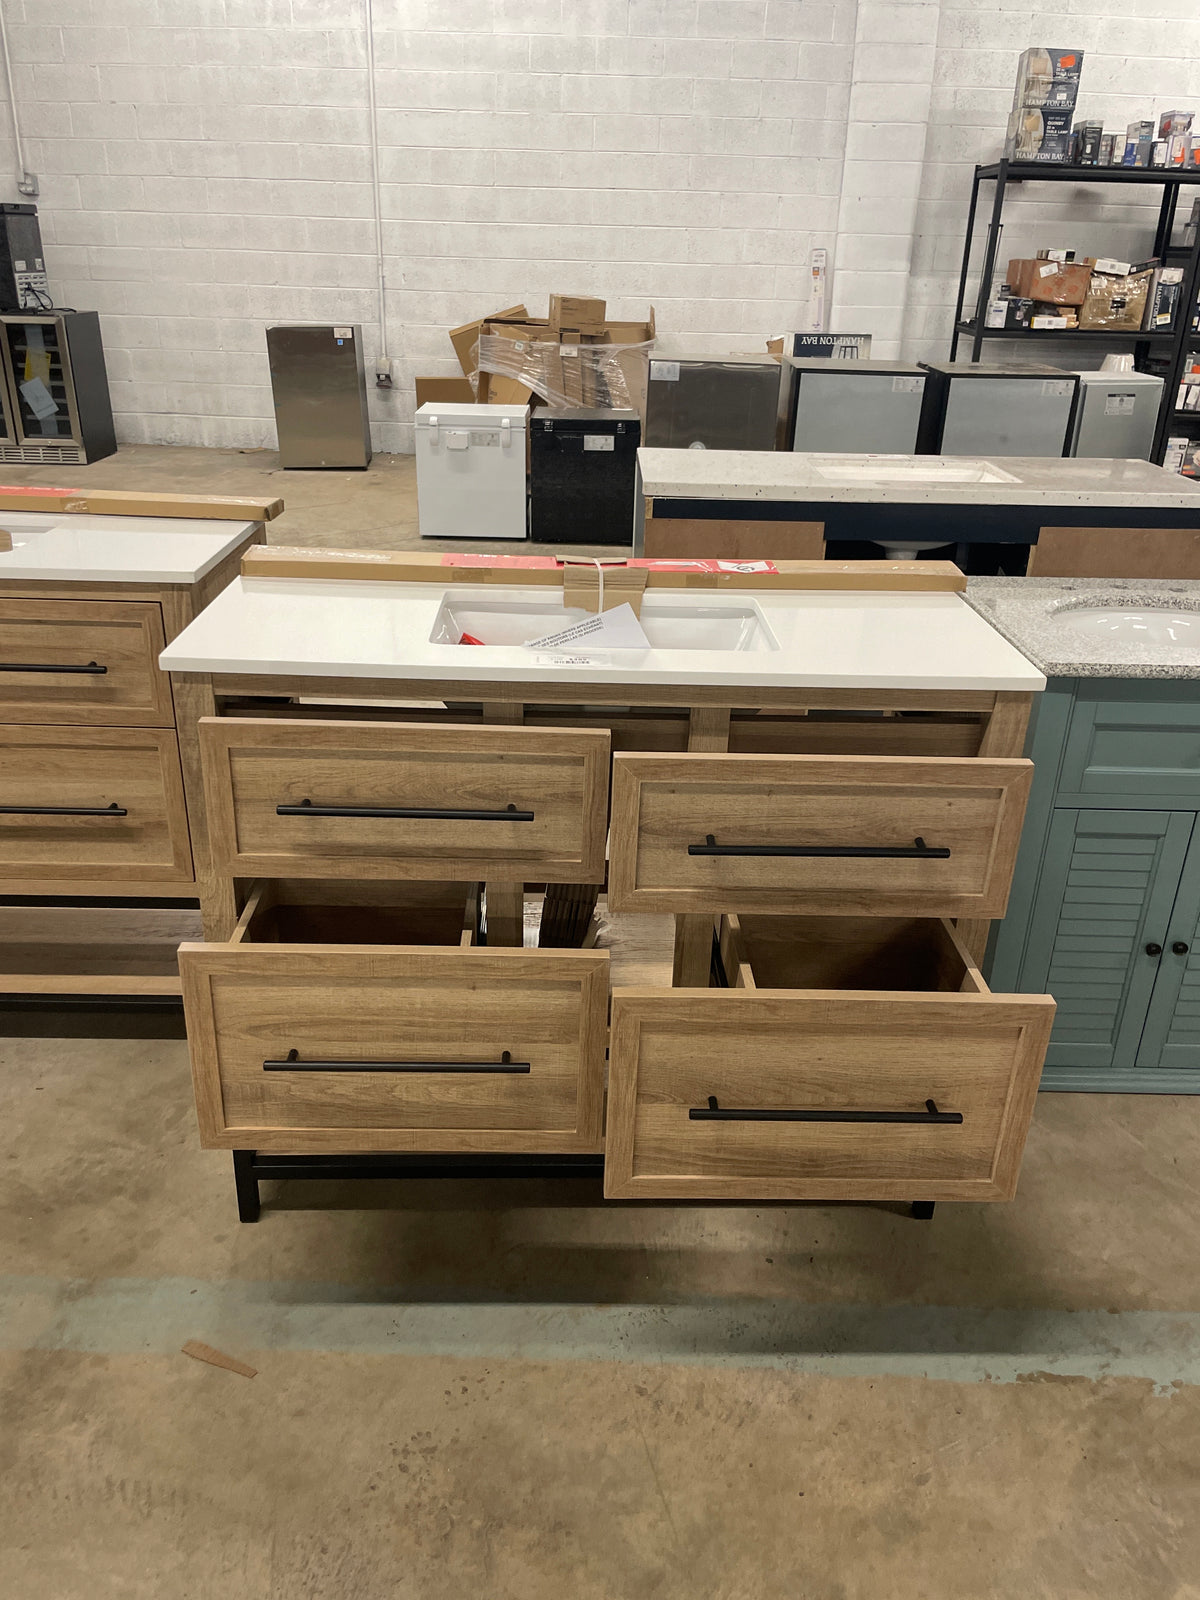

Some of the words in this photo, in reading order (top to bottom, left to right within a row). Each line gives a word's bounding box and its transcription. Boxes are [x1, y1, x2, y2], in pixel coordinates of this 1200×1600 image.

[1025, 99, 1060, 107] HAMPTON
[1060, 100, 1075, 108] BAY
[1015, 151, 1051, 160] HAMPTON
[1051, 152, 1065, 161] BAY
[801, 336, 819, 345] BAY
[819, 336, 865, 346] HAMPTON
[576, 617, 602, 629] APPLICABLE)
